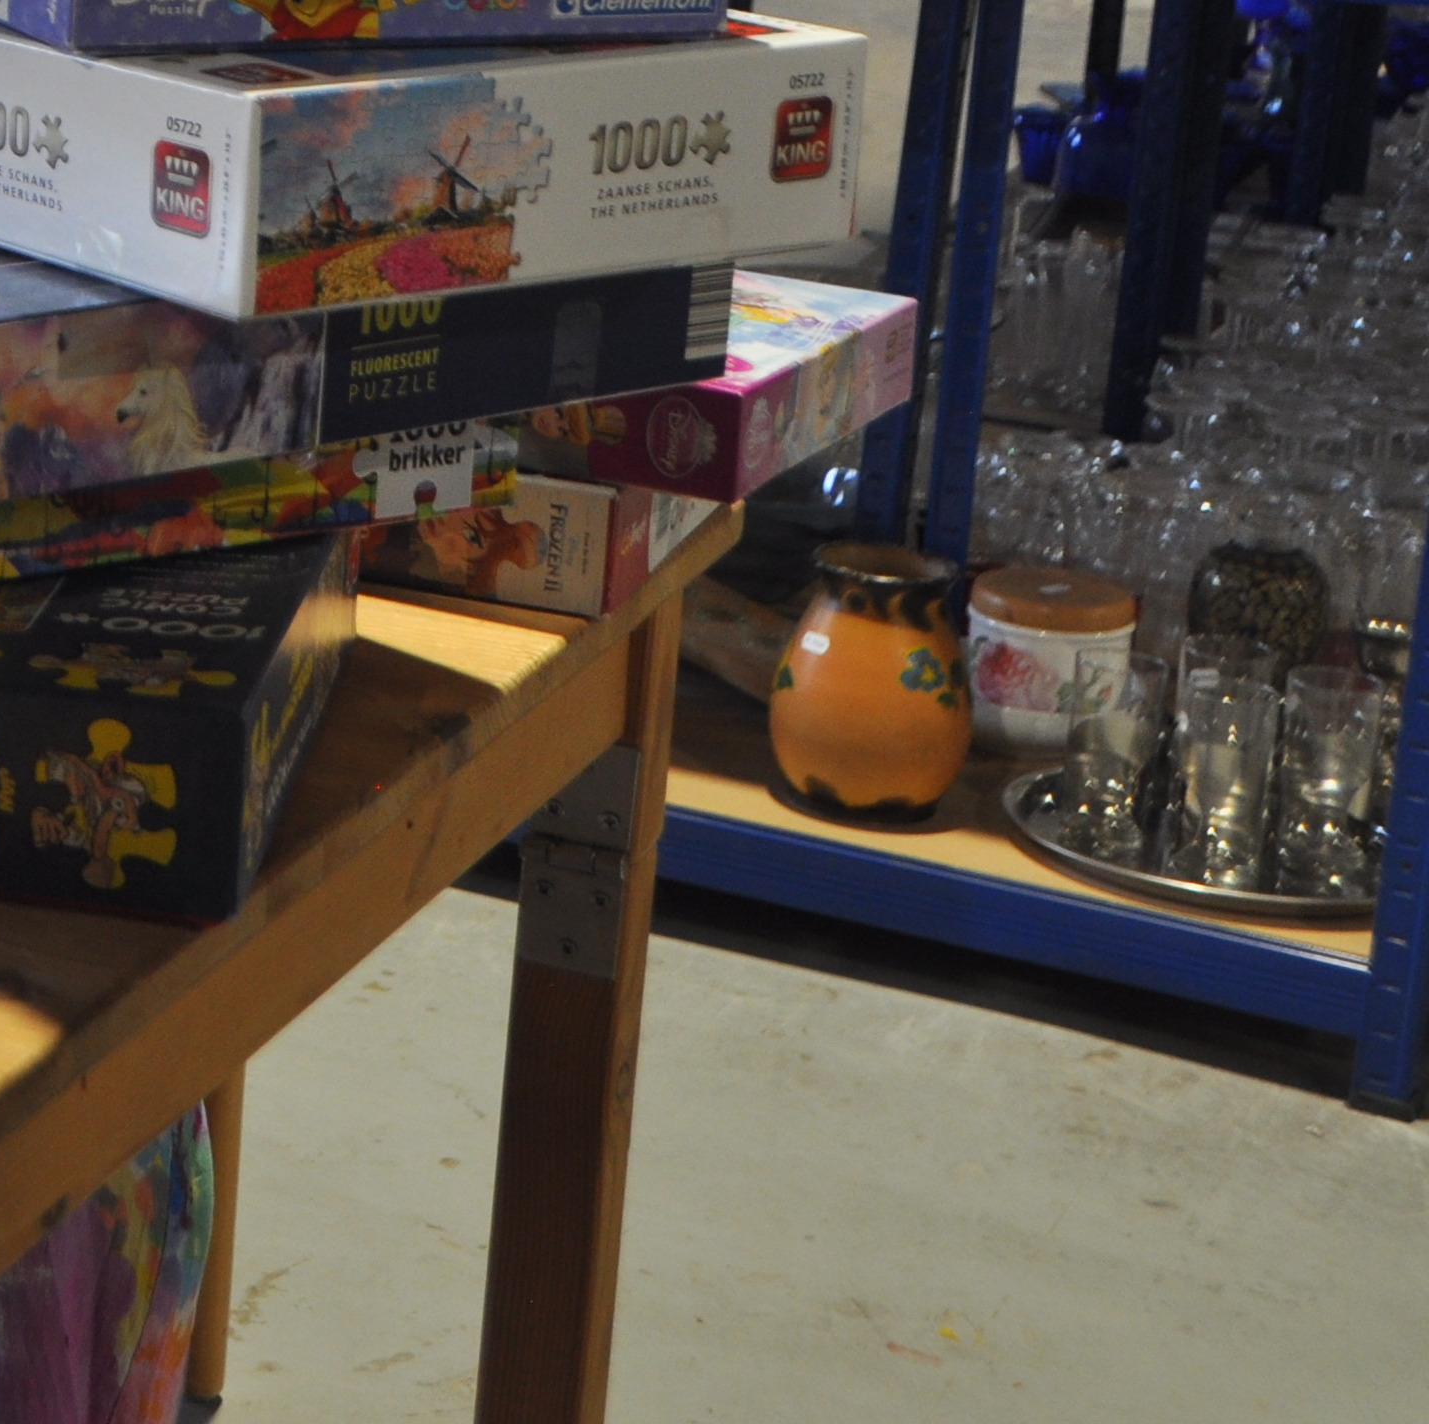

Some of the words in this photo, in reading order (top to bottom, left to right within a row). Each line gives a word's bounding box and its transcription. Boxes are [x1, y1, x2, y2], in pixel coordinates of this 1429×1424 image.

[149, 3, 194, 17] Puzzle
[788, 72, 826, 90] 05722
[165, 116, 204, 139] 05722
[588, 113, 689, 176] 1000
[775, 140, 827, 166] KING
[8, 167, 60, 194] SCHANS,
[596, 177, 652, 200] ZAANSE
[155, 186, 207, 223] KING
[590, 204, 616, 220] THE
[621, 192, 719, 216] NETHERLANDS
[349, 347, 441, 378] FLUORESCENT
[347, 371, 439, 404] PUZZLE
[387, 441, 467, 475] brikker
[545, 502, 569, 570] FROZEN
